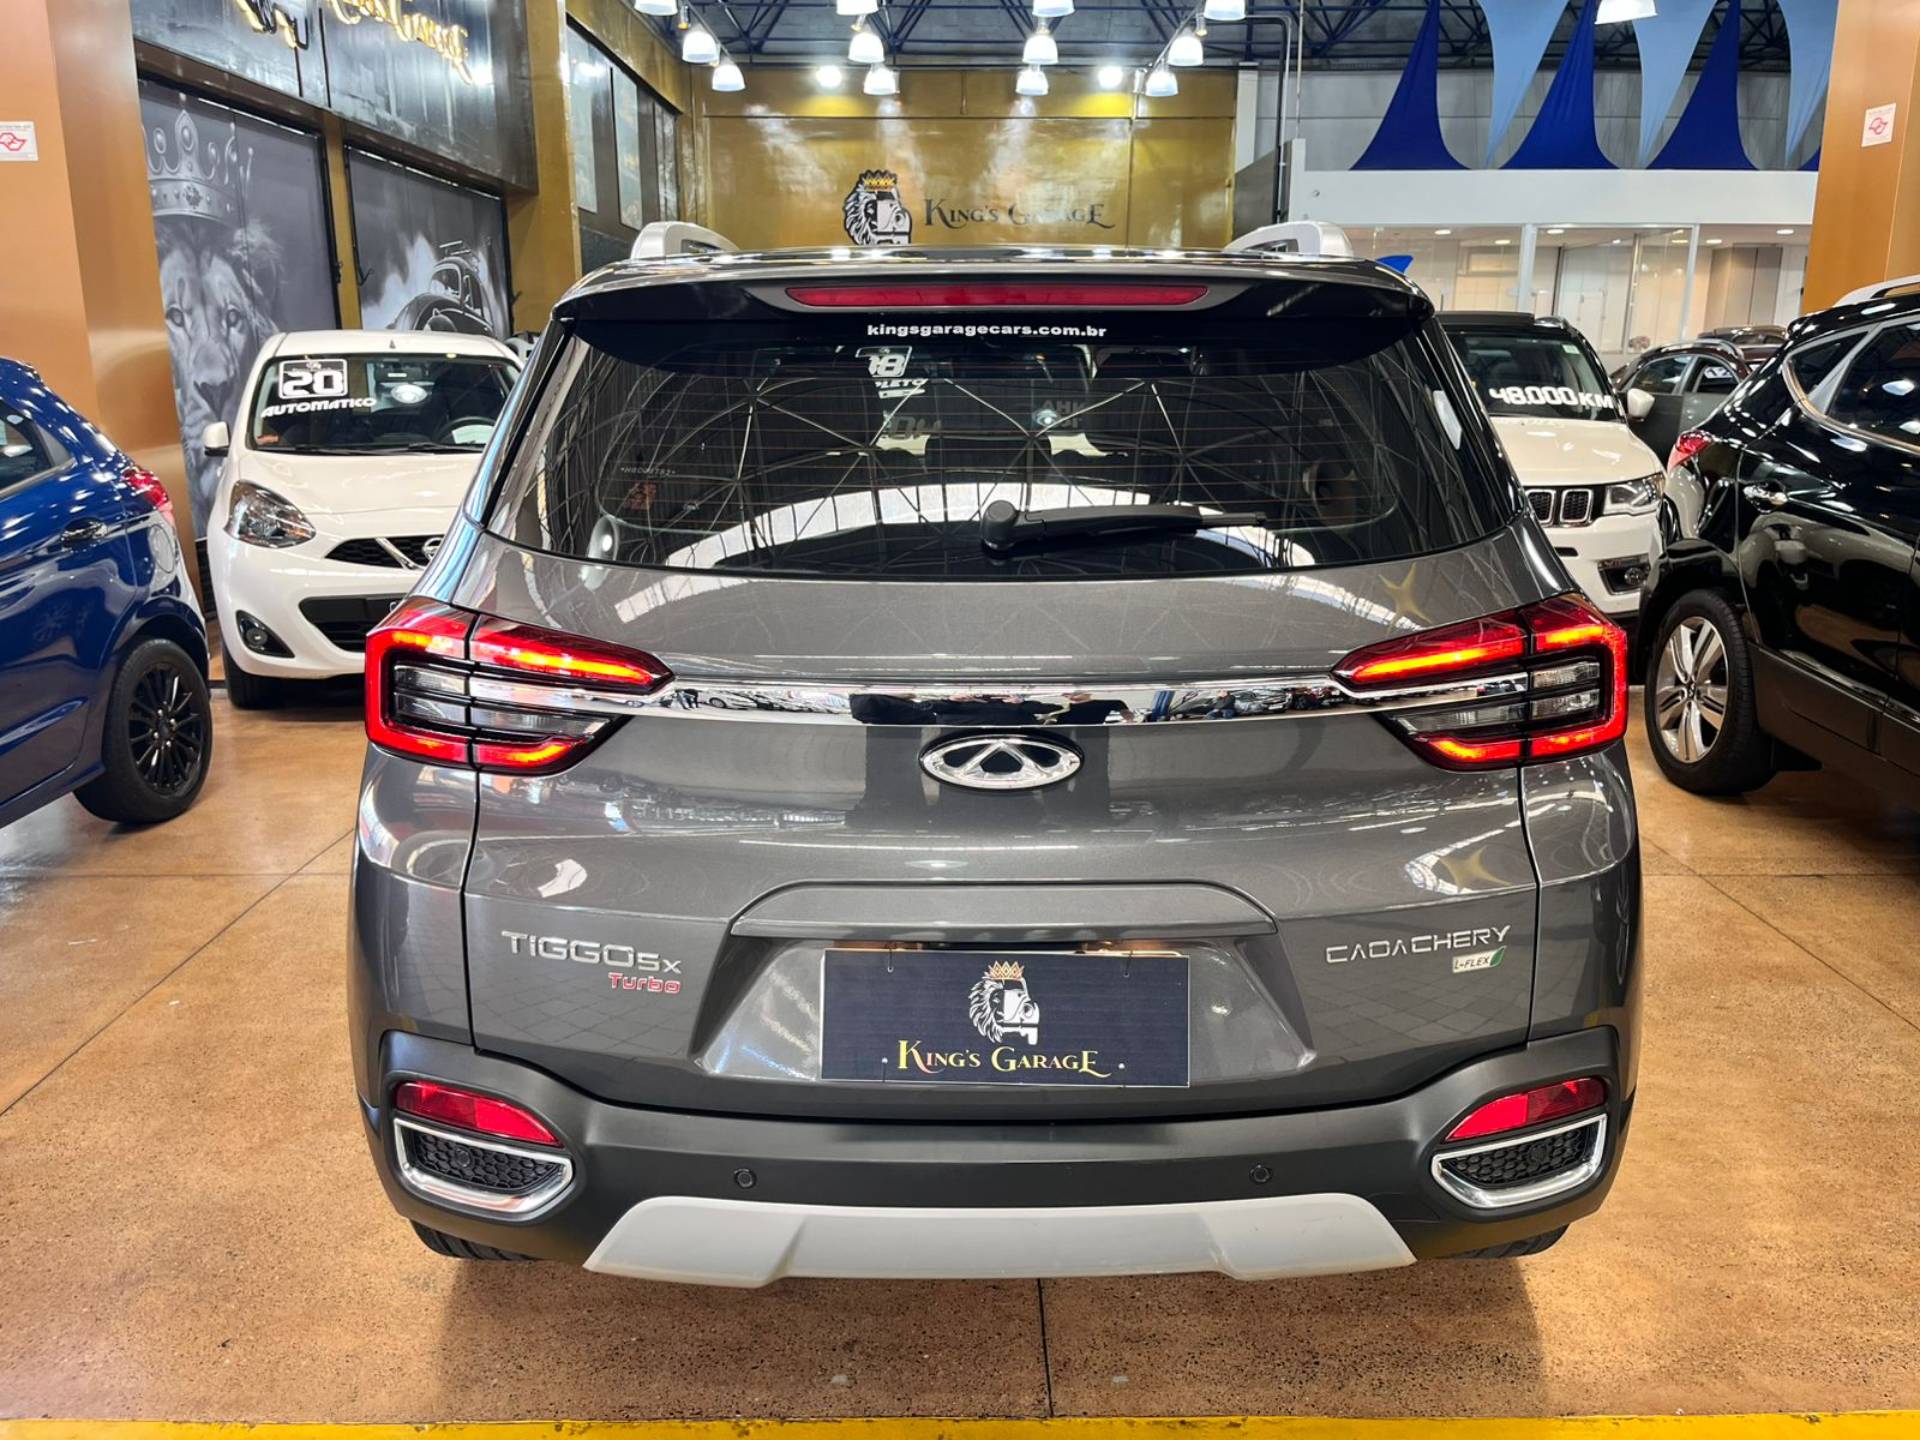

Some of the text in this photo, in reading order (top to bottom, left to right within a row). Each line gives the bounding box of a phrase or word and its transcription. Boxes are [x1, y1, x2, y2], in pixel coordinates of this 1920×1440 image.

[1008, 203, 1116, 229] GGE
[867, 324, 1107, 337] kingsgaragecars.com.br
[282, 369, 345, 397] 20
[260, 397, 377, 418] AUTOMATICO
[608, 972, 681, 994] Turbo
[897, 1040, 1113, 1078] KING'S GARAGE
